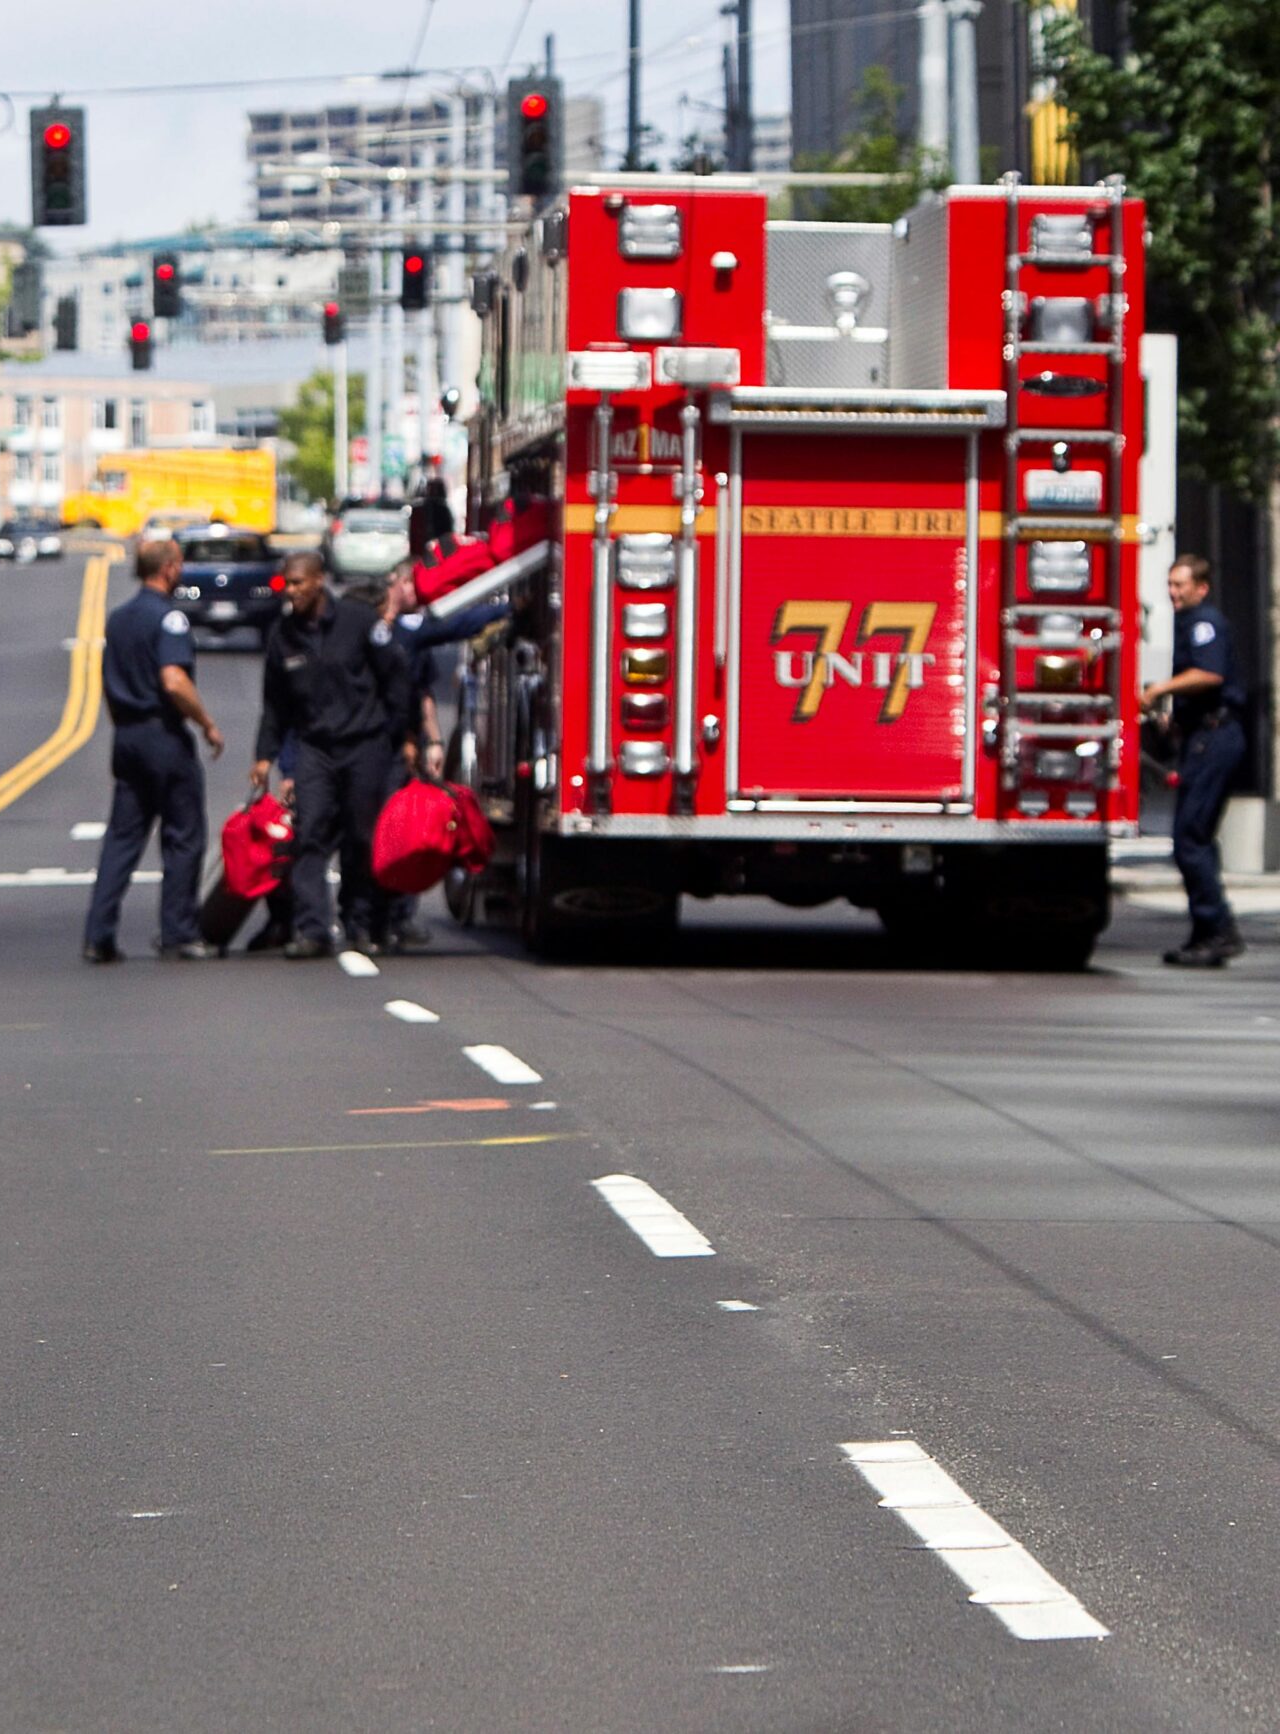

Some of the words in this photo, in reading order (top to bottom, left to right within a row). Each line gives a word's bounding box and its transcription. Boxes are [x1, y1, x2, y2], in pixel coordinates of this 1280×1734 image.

[749, 511, 876, 531] SEATTLE
[893, 513, 959, 532] FIRE
[769, 600, 939, 724] 77
[774, 651, 937, 689] UNIT
